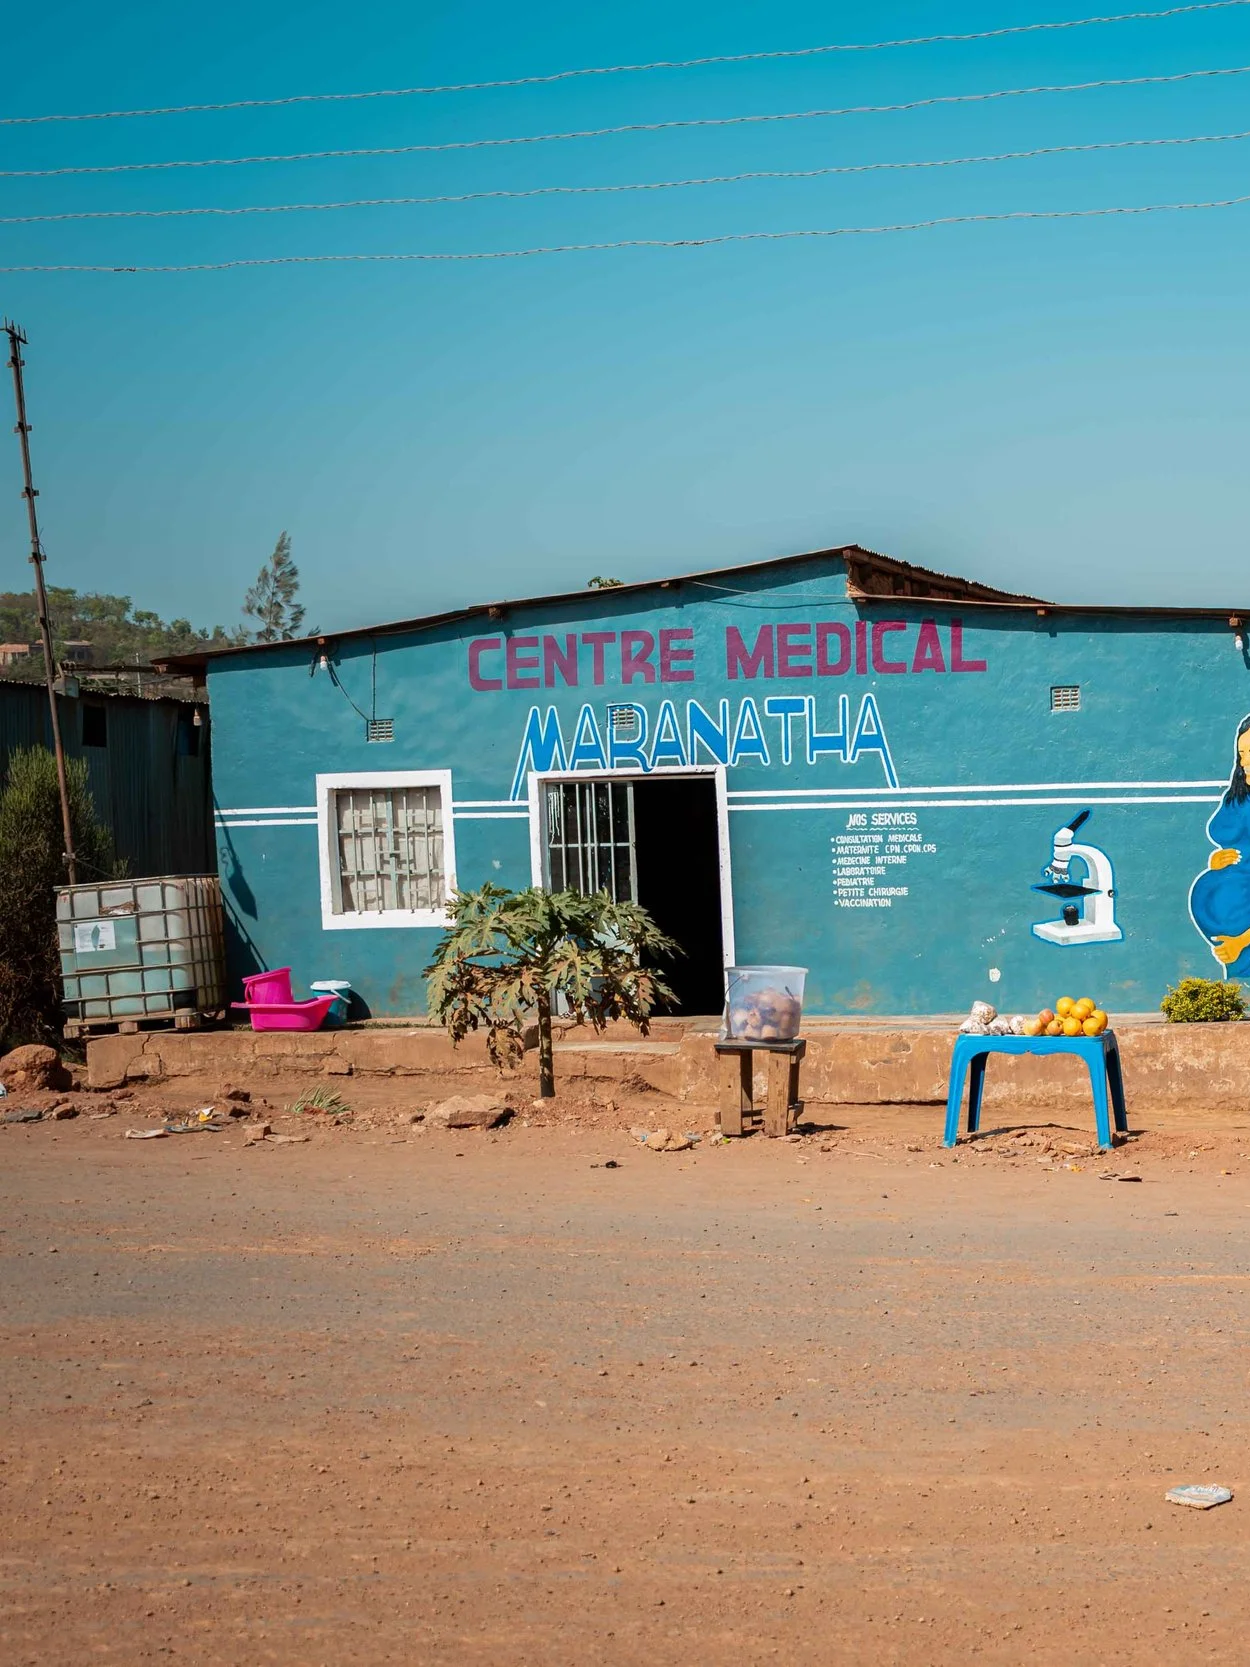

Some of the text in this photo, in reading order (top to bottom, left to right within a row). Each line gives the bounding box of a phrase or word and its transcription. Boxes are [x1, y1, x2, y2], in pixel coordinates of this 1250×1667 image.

[468, 618, 988, 692] CENTRE MEDICAL
[511, 693, 899, 802] MARANATHA
[846, 812, 918, 828] NOS SERVICES
[835, 834, 923, 844] CONSULTATION MEDICALE
[836, 845, 880, 854] MATERNITE
[875, 856, 907, 865] INTERNE
[837, 866, 886, 876] LABORATOIRE
[838, 887, 909, 897] PETITE CHIRURGIE
[839, 899, 892, 908] VACCINATION
